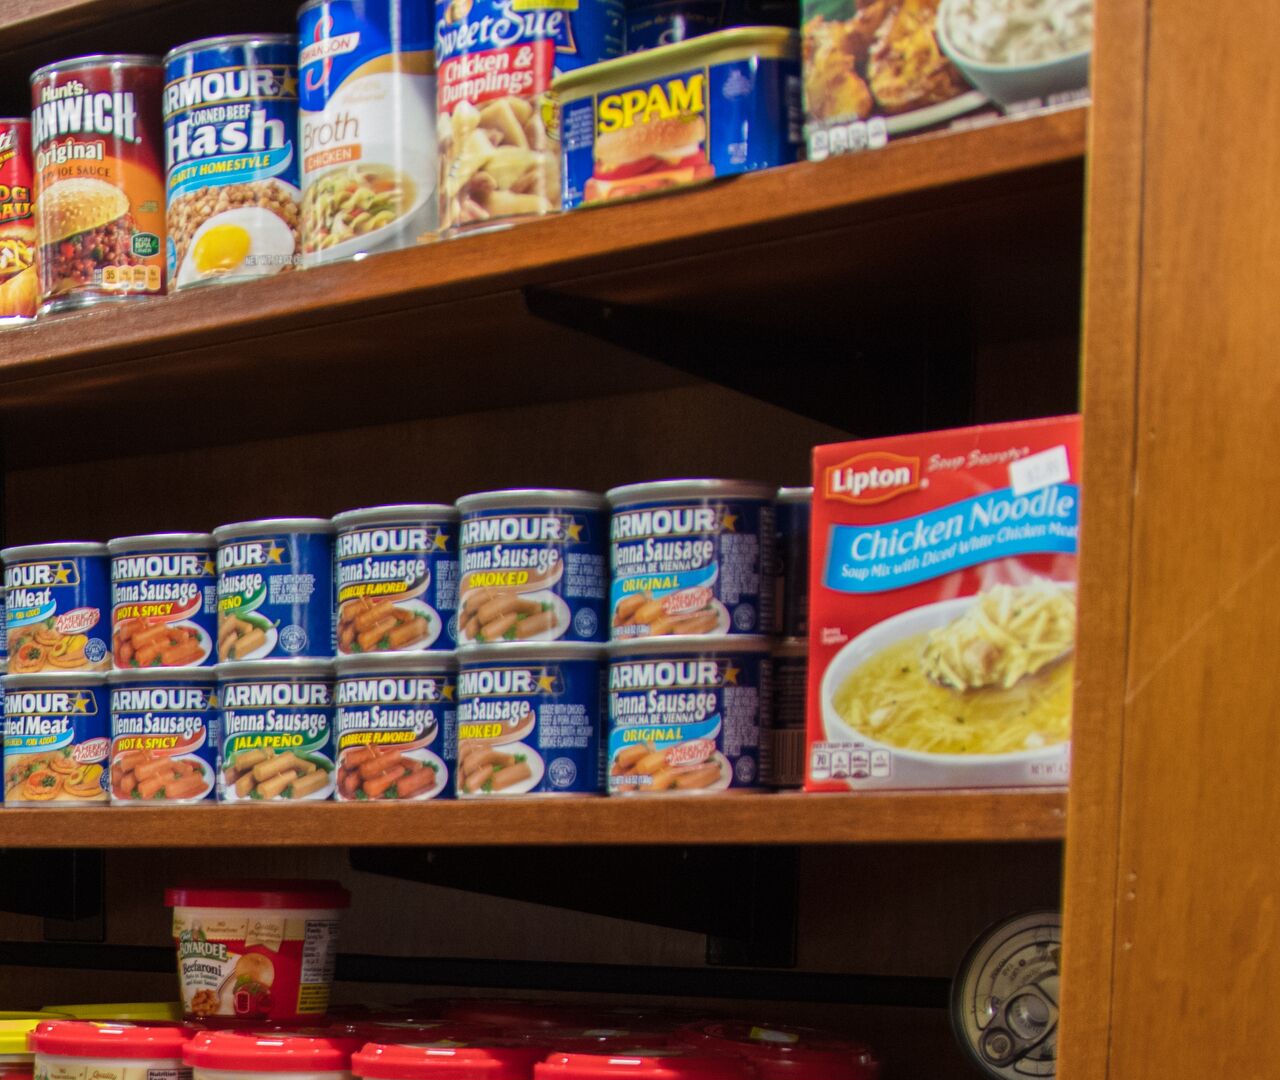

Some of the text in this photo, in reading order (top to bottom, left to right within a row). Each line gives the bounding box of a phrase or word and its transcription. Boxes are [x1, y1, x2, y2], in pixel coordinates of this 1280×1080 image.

[300, 37, 351, 63] SWANSON
[443, 46, 533, 82] Chicken &
[42, 81, 83, 102] Hunt's
[442, 70, 533, 101] Dumplings
[597, 74, 705, 134] SPAM
[189, 104, 251, 126] CORNED BEEF
[167, 111, 285, 168] Hash
[303, 114, 360, 152] Broth
[199, 155, 271, 176] HOMESTYLE
[307, 148, 352, 169] CHICKEN
[58, 165, 111, 178] JOE SAUCE
[831, 464, 911, 495] Lipton
[850, 487, 1074, 561] Chicken Noodle
[644, 538, 714, 574] Sausage
[664, 558, 691, 572] VIENNA
[468, 570, 528, 588] SMOKED
[622, 576, 680, 592] ORIGINAL
[18, 588, 52, 607] Meat
[30, 717, 71, 735] Meat
[225, 708, 328, 740] Vienna Sausage
[234, 732, 305, 751] JALAPEÑO
[622, 728, 683, 743] ORIGINAL
